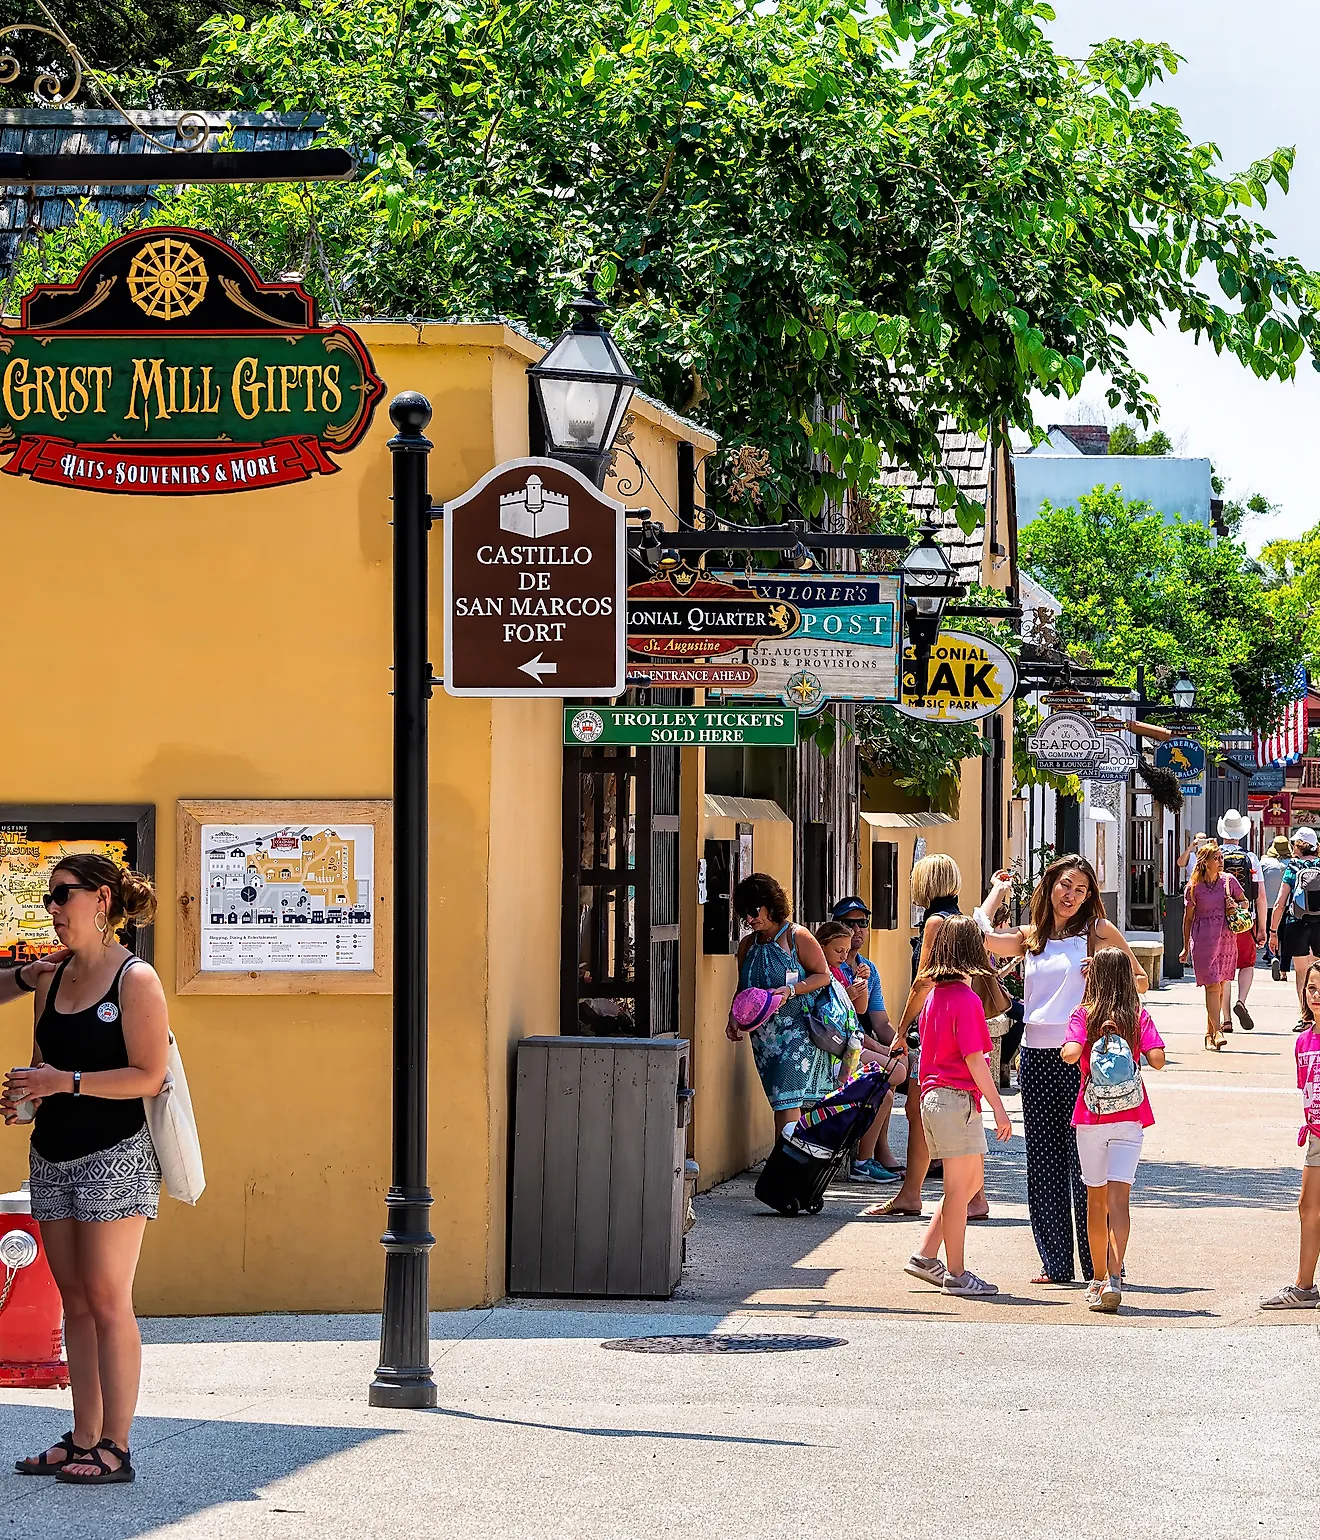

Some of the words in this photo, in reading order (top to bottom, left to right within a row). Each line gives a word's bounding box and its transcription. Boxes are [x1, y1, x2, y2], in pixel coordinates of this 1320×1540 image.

[214, 463, 228, 482] &
[230, 456, 278, 483] MORE
[476, 545, 593, 565] CASTILLO
[518, 572, 551, 591] DE
[758, 586, 868, 601] XPLORER'S
[455, 597, 503, 616] SAN
[509, 597, 613, 616] MARCOS
[626, 611, 682, 626] LONIAL
[687, 607, 767, 631] QUARTER
[502, 623, 566, 643] FORT
[644, 638, 661, 652] St.
[663, 638, 720, 654] Augustine
[752, 648, 771, 656] ST.
[775, 648, 853, 658] AUGUSTINE
[903, 647, 988, 661] CLONIAL
[731, 657, 777, 667] GODS
[796, 660, 877, 669] PROVISIONS
[651, 670, 708, 681] ENTRANCE
[712, 670, 750, 681] AHEAD
[949, 700, 979, 710] PARK
[612, 713, 699, 727] TROLLEY
[704, 713, 784, 727] TICKETS
[650, 729, 694, 742] SOLD
[699, 729, 744, 742] HERE
[1031, 740, 1100, 750] SEAFOOD
[1163, 741, 1199, 752] TABERNA
